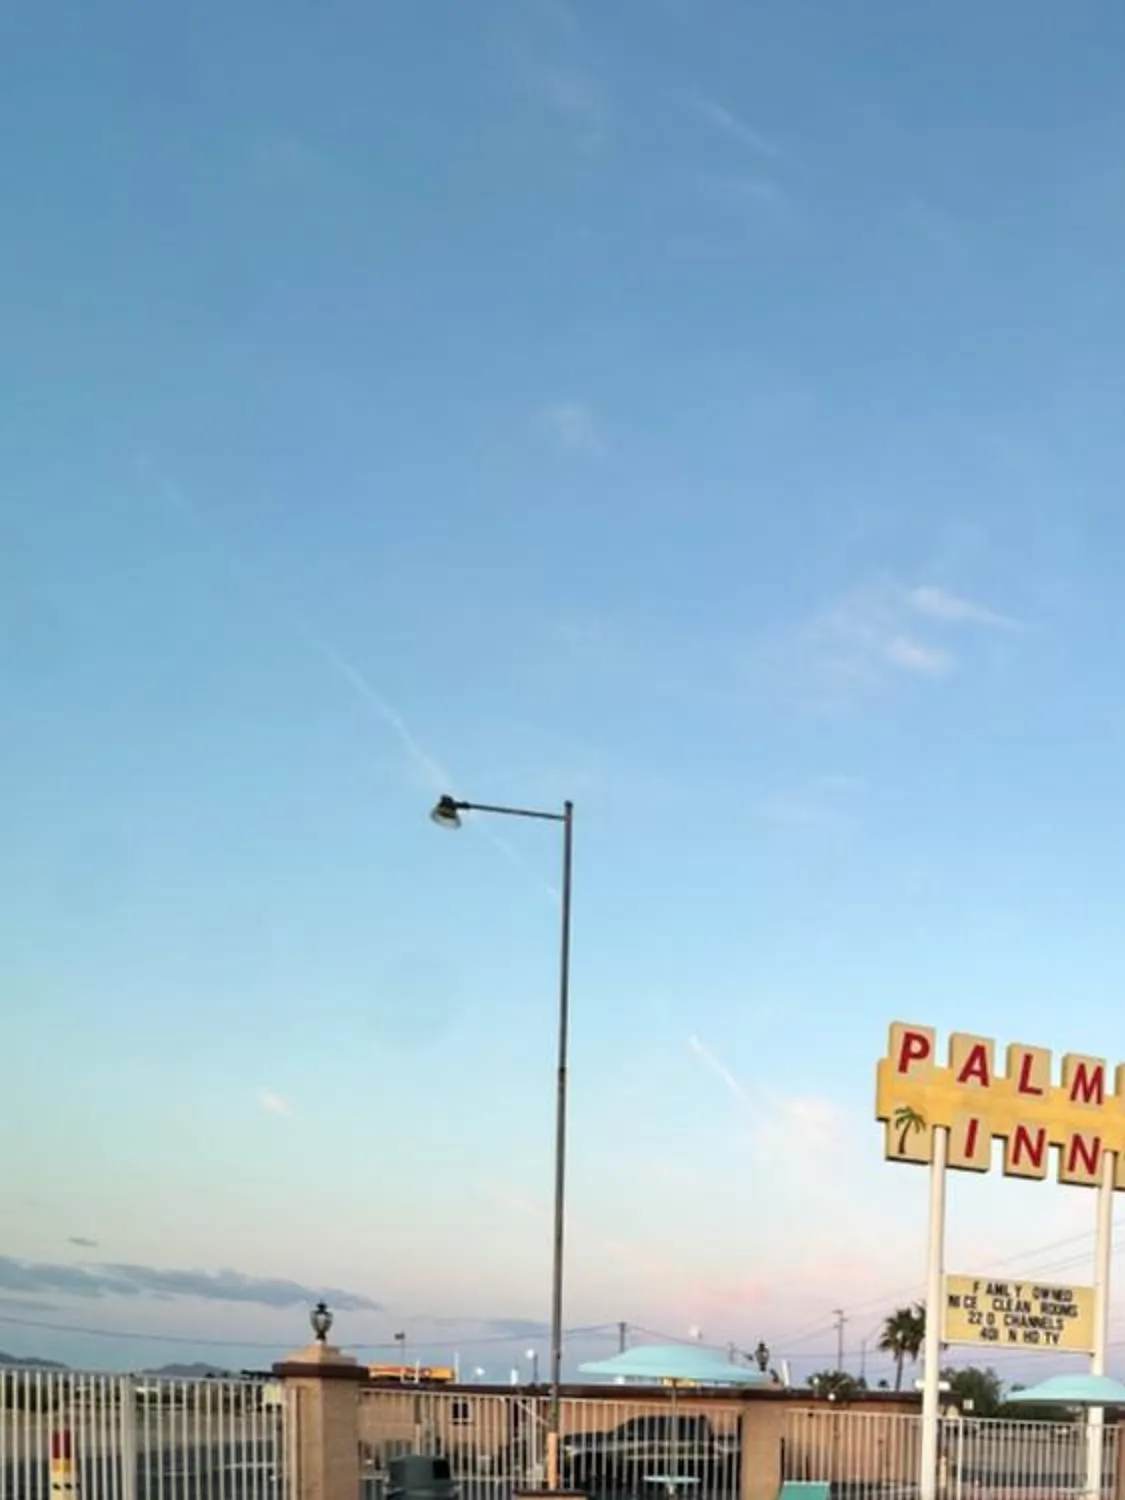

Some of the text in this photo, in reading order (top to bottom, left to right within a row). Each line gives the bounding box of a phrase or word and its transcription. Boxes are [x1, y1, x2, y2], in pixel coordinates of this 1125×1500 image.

[964, 1118, 1101, 1175] INN
[1032, 1286, 1074, 1303] OWNED
[948, 1294, 1078, 1318] NICE CLEAN ROOMS
[1004, 1313, 1064, 1331] CHANNELS
[1044, 1331, 1061, 1345] TV
